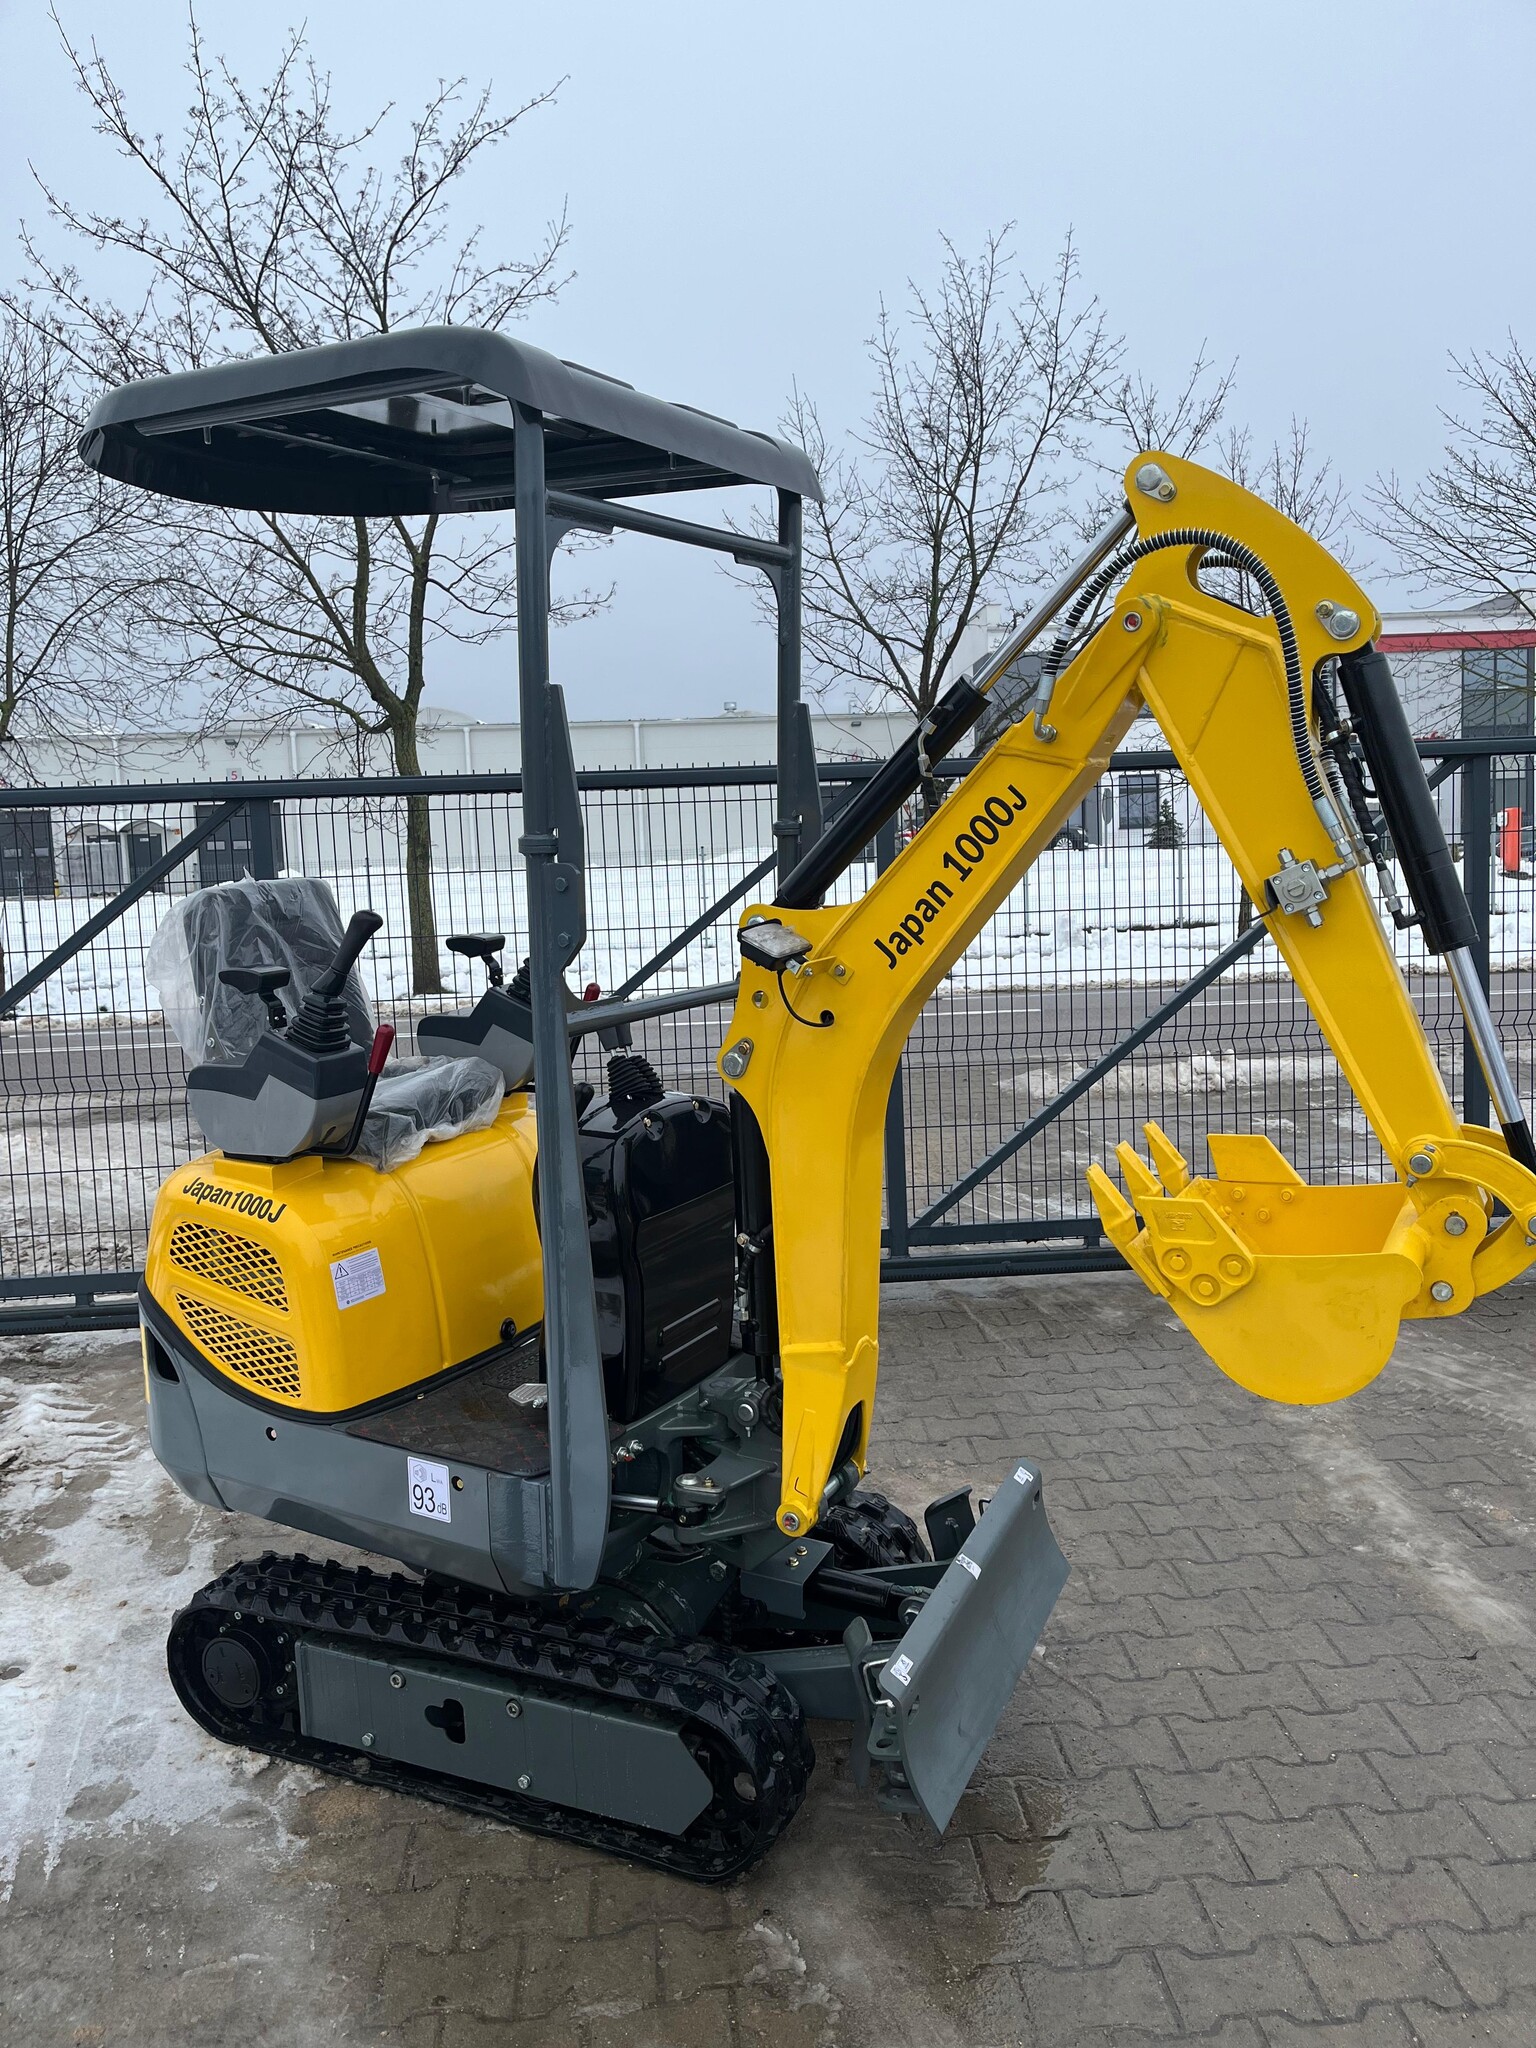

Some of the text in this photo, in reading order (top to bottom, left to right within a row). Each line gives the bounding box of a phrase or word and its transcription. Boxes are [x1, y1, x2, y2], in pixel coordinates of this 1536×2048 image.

[231, 770, 238, 780] 5
[873, 784, 1027, 970] Japan 1000J
[183, 1176, 287, 1223] Japan1000J
[412, 1484, 447, 1515] 93 dB
